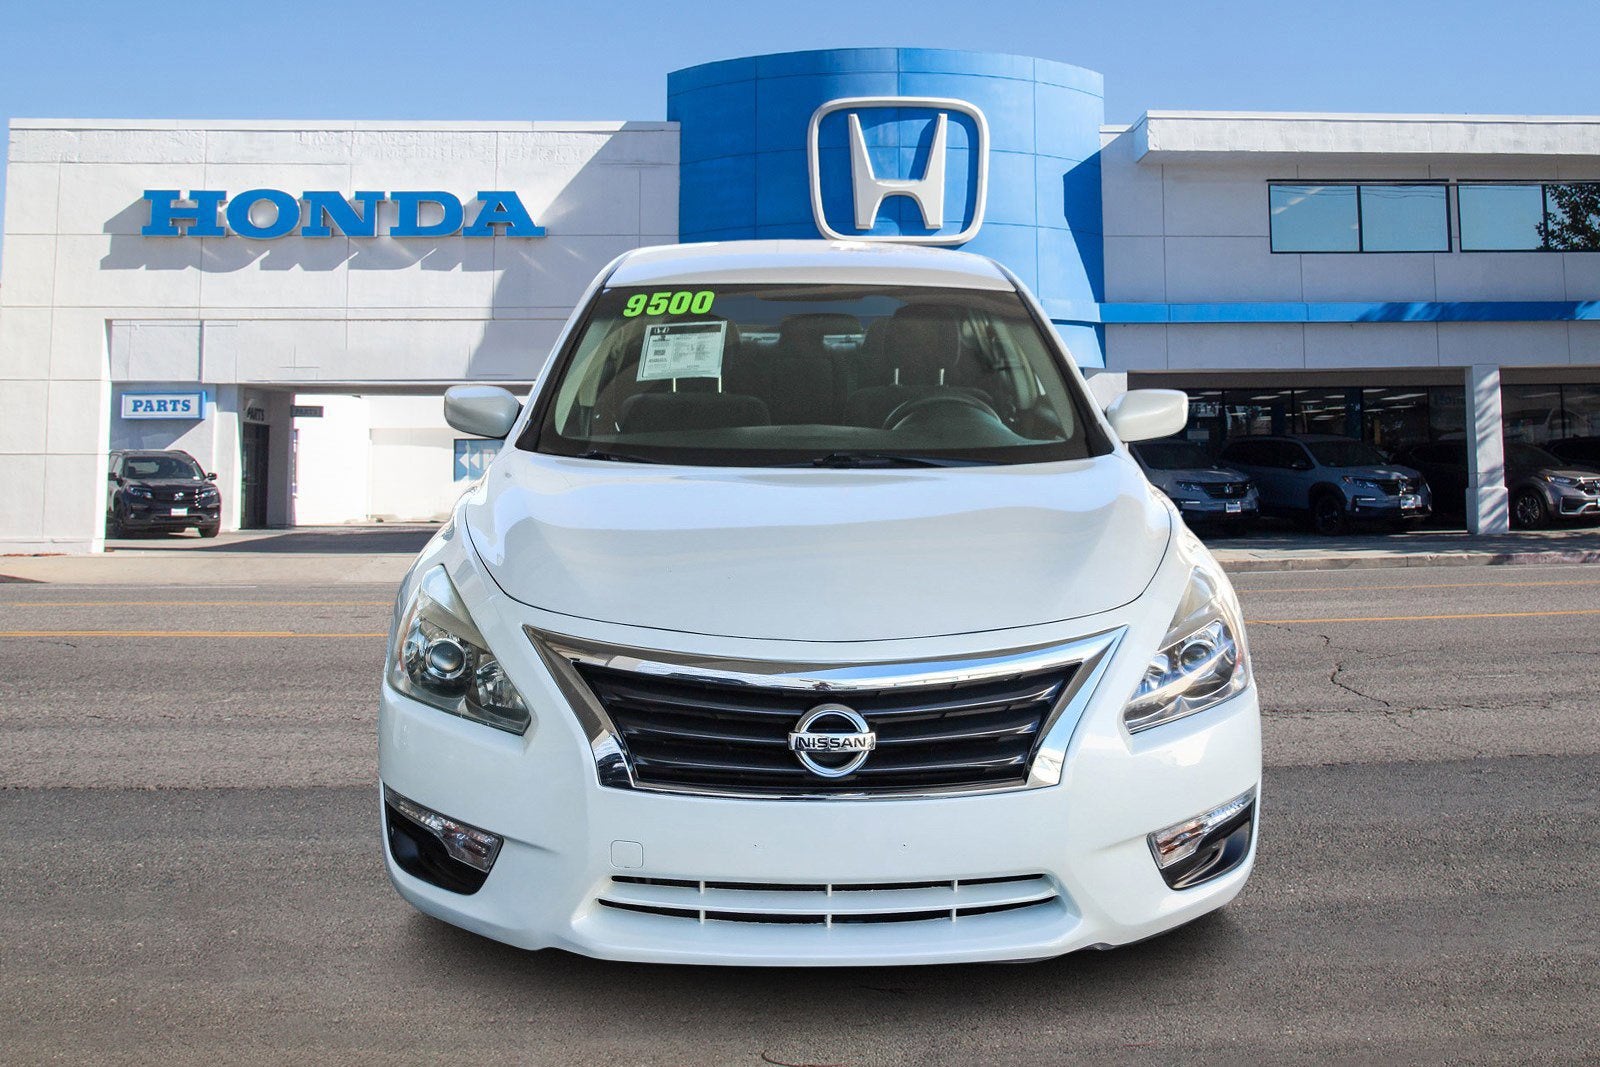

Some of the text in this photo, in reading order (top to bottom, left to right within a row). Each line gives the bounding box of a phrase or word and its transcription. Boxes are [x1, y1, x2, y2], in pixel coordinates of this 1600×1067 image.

[141, 188, 547, 240] HONDA
[623, 290, 715, 317] 9500
[131, 399, 191, 412] PARTS
[797, 736, 866, 749] NISSAN
